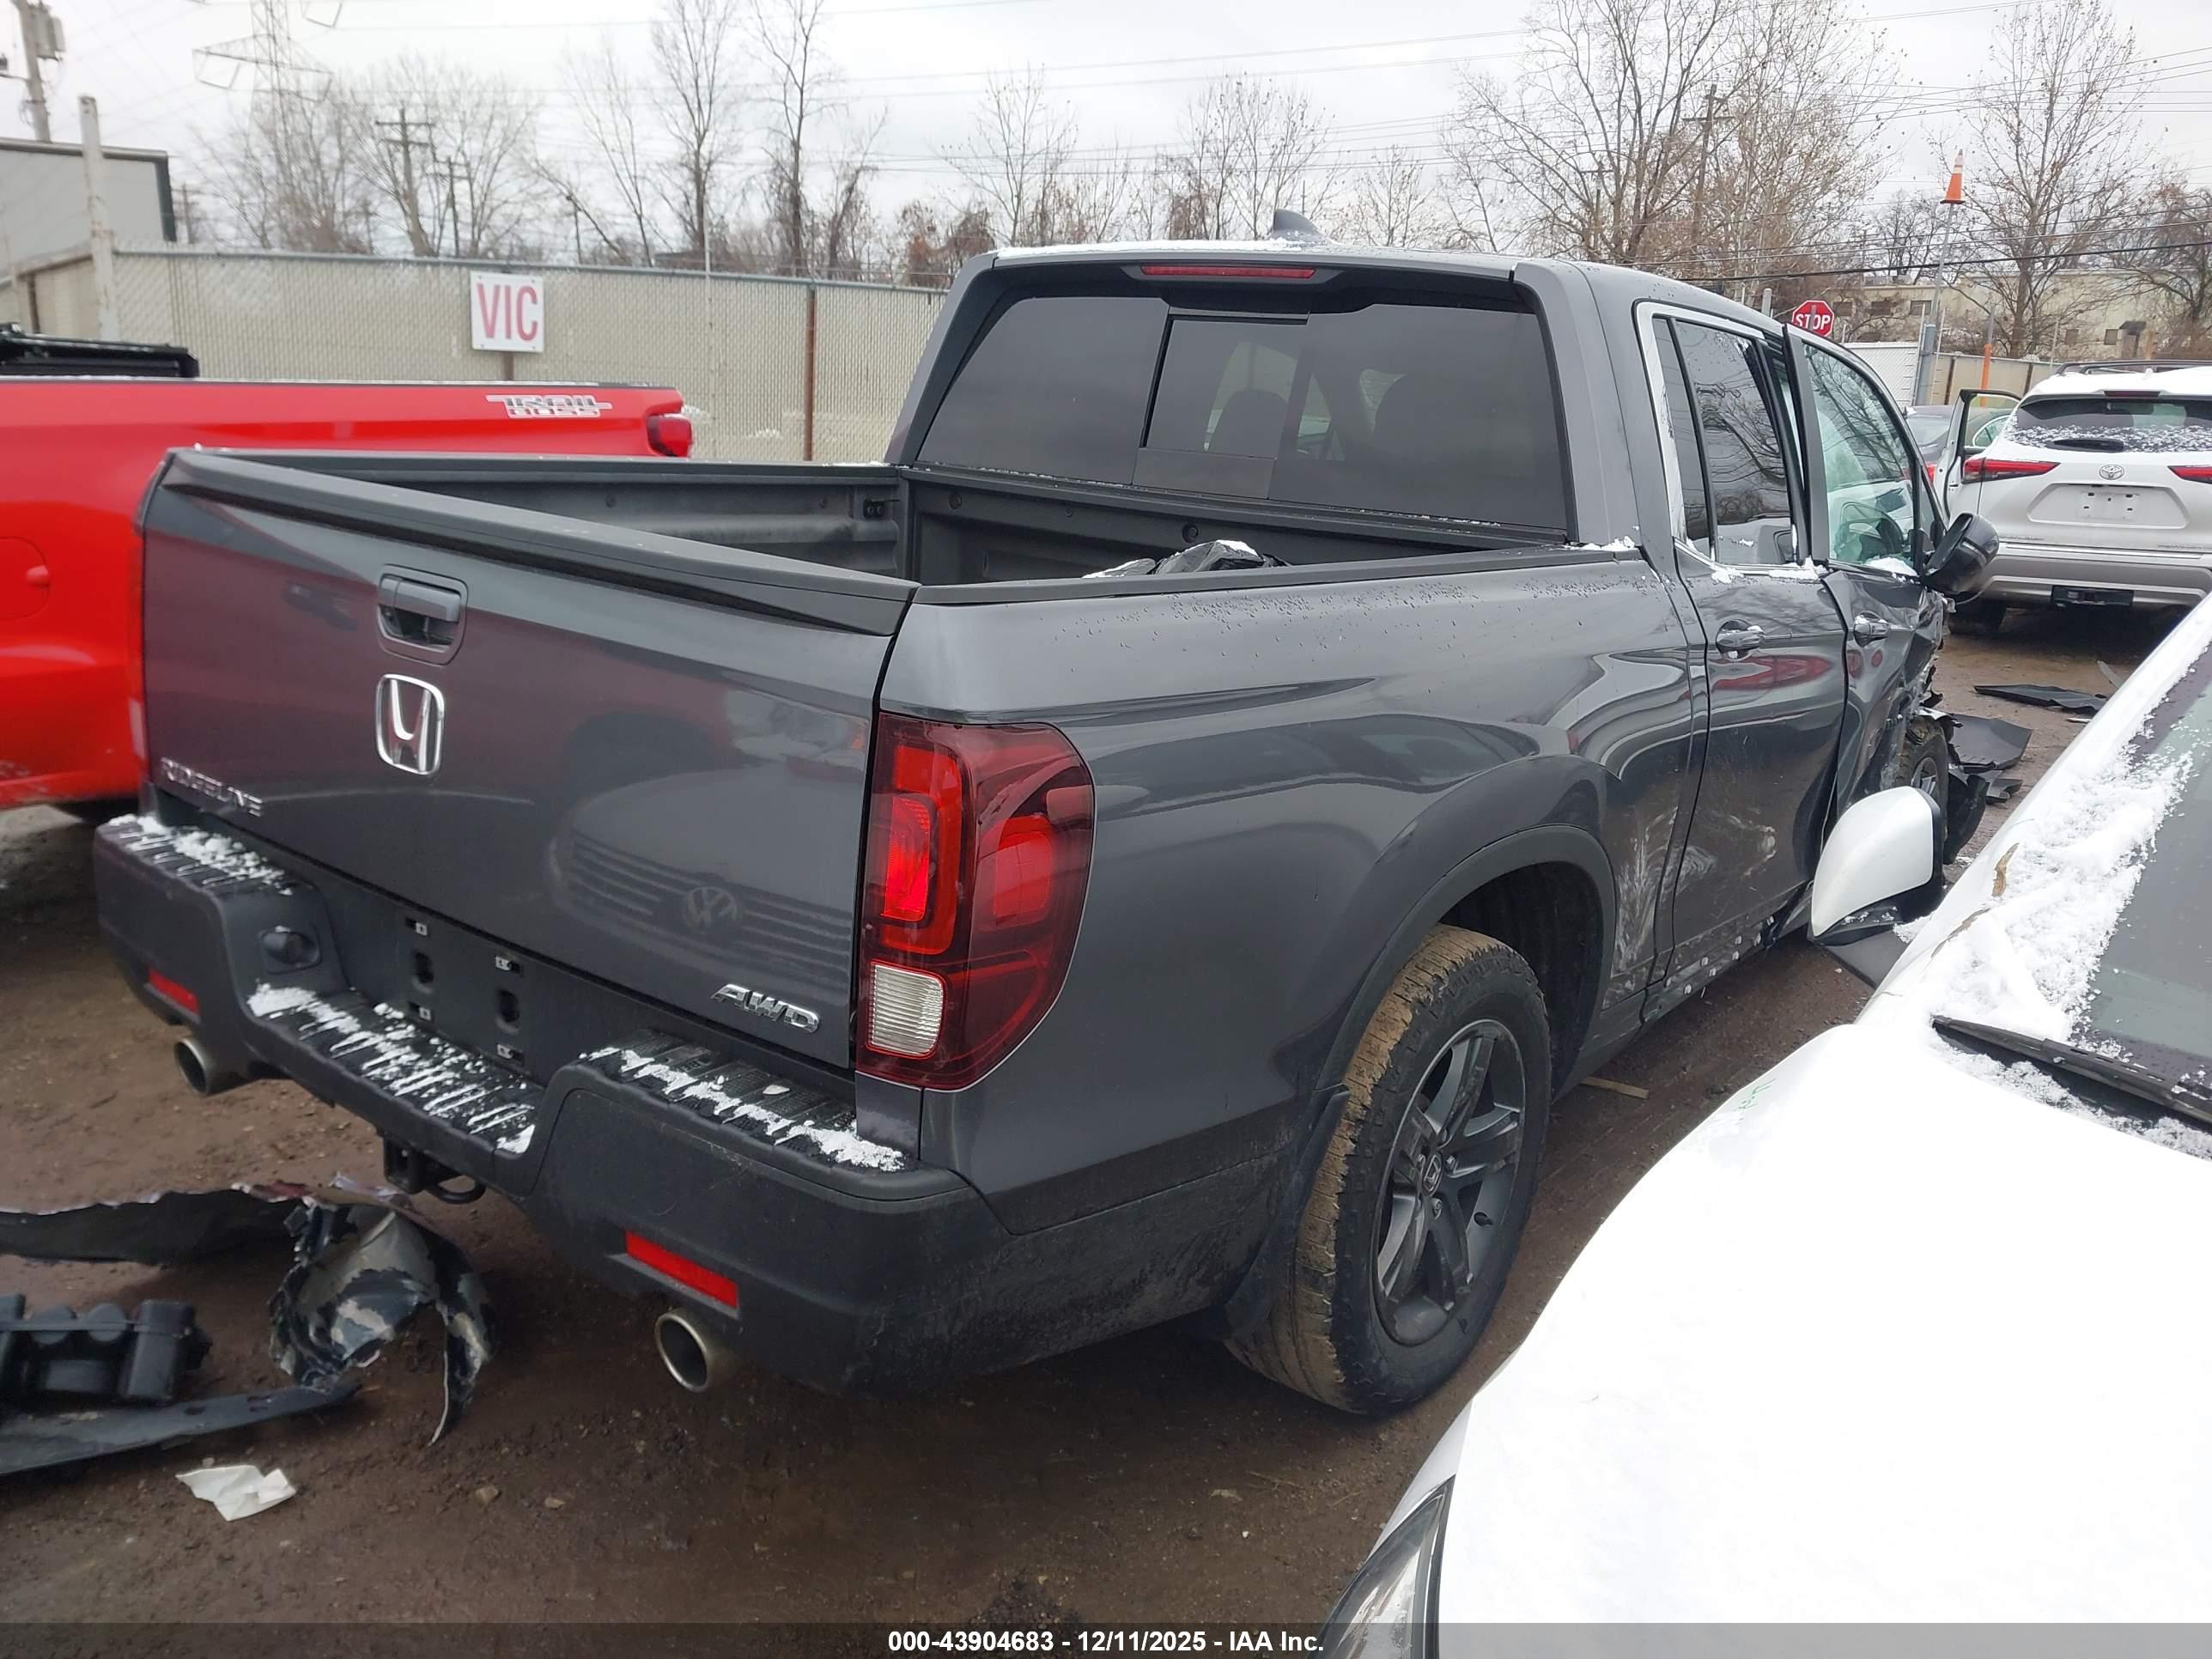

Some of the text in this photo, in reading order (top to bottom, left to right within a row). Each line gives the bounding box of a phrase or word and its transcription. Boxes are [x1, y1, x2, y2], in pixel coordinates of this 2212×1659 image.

[477, 283, 538, 342] VIC
[1796, 313, 1831, 331] STOP
[485, 394, 613, 410] TRAIL
[507, 407, 601, 419] BOSS
[710, 983, 819, 1033] AWD
